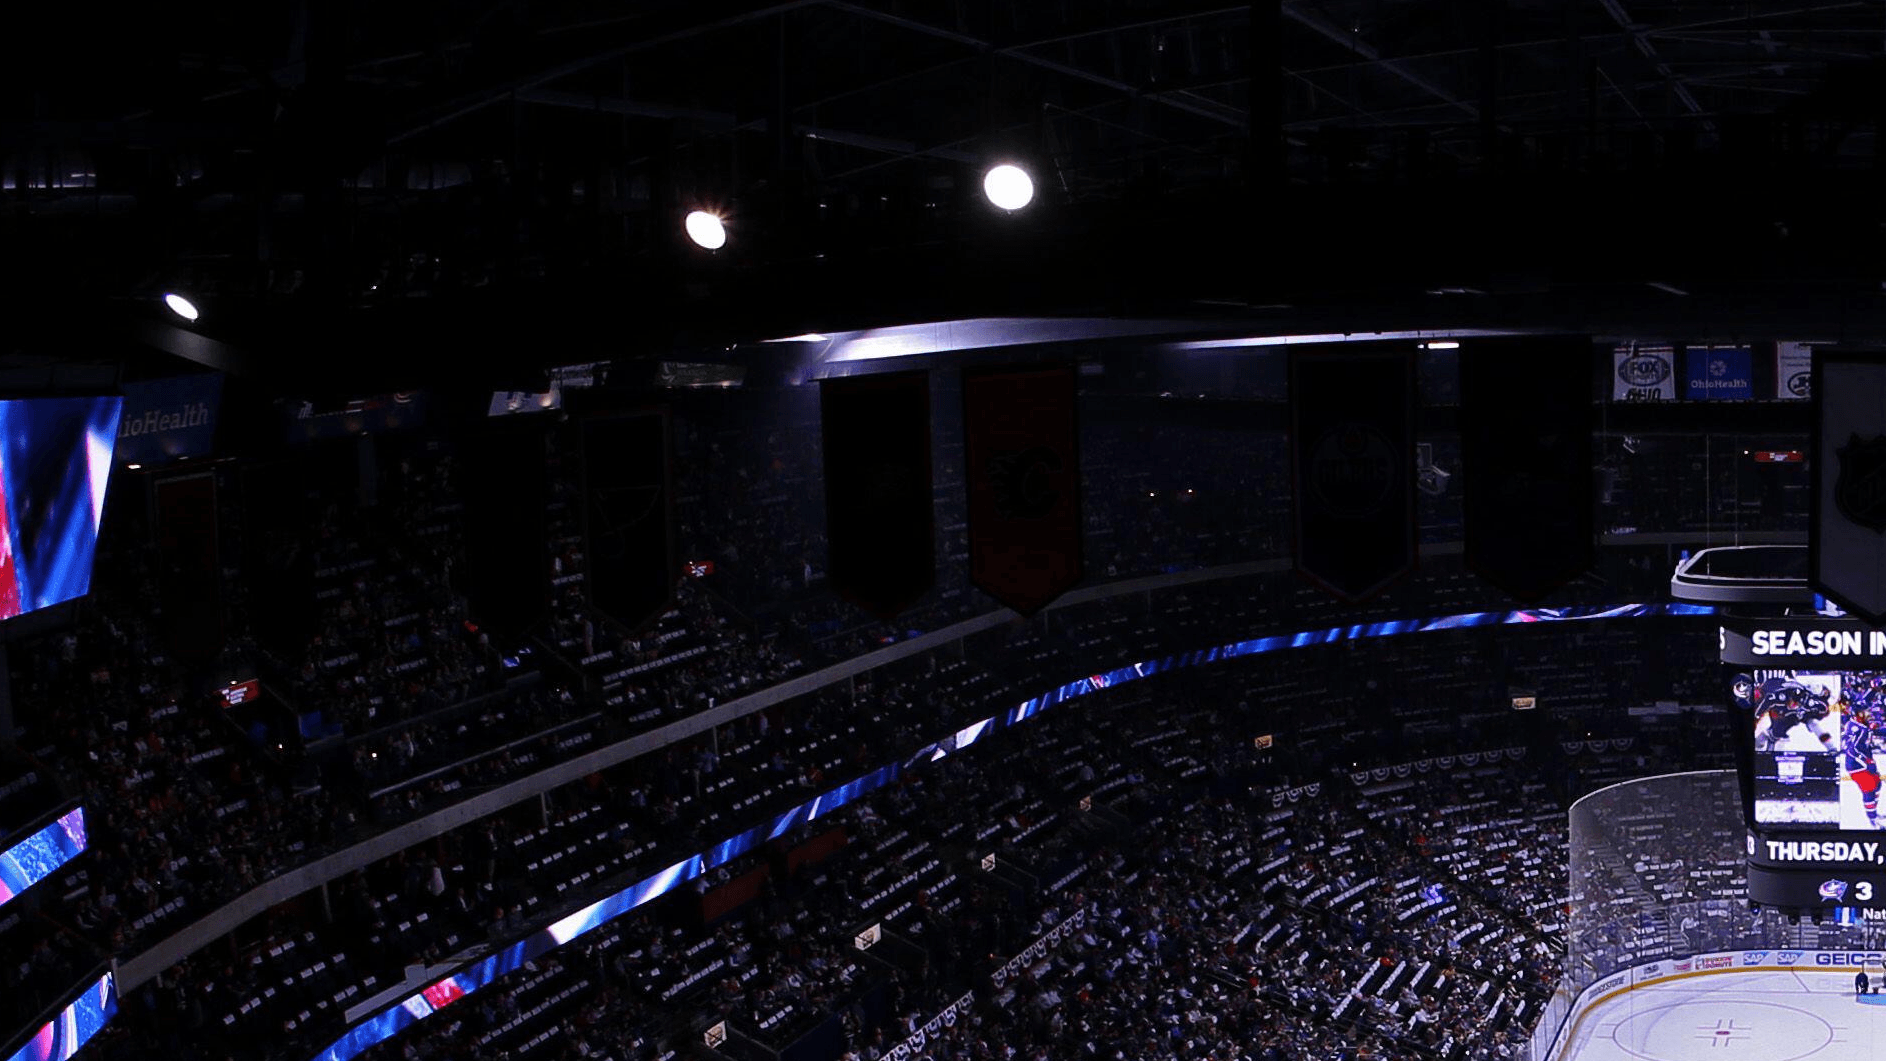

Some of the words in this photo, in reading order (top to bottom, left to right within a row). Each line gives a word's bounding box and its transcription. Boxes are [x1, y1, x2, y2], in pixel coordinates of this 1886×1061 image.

[1630, 361, 1659, 375] FOX
[1690, 378, 1748, 390] OhioHealth
[1752, 630, 1866, 656] SEASON
[1766, 840, 1885, 865] THURSDAY,
[1855, 881, 1873, 901] 3
[1744, 953, 1765, 964] SAP
[1777, 953, 1799, 964] SAP
